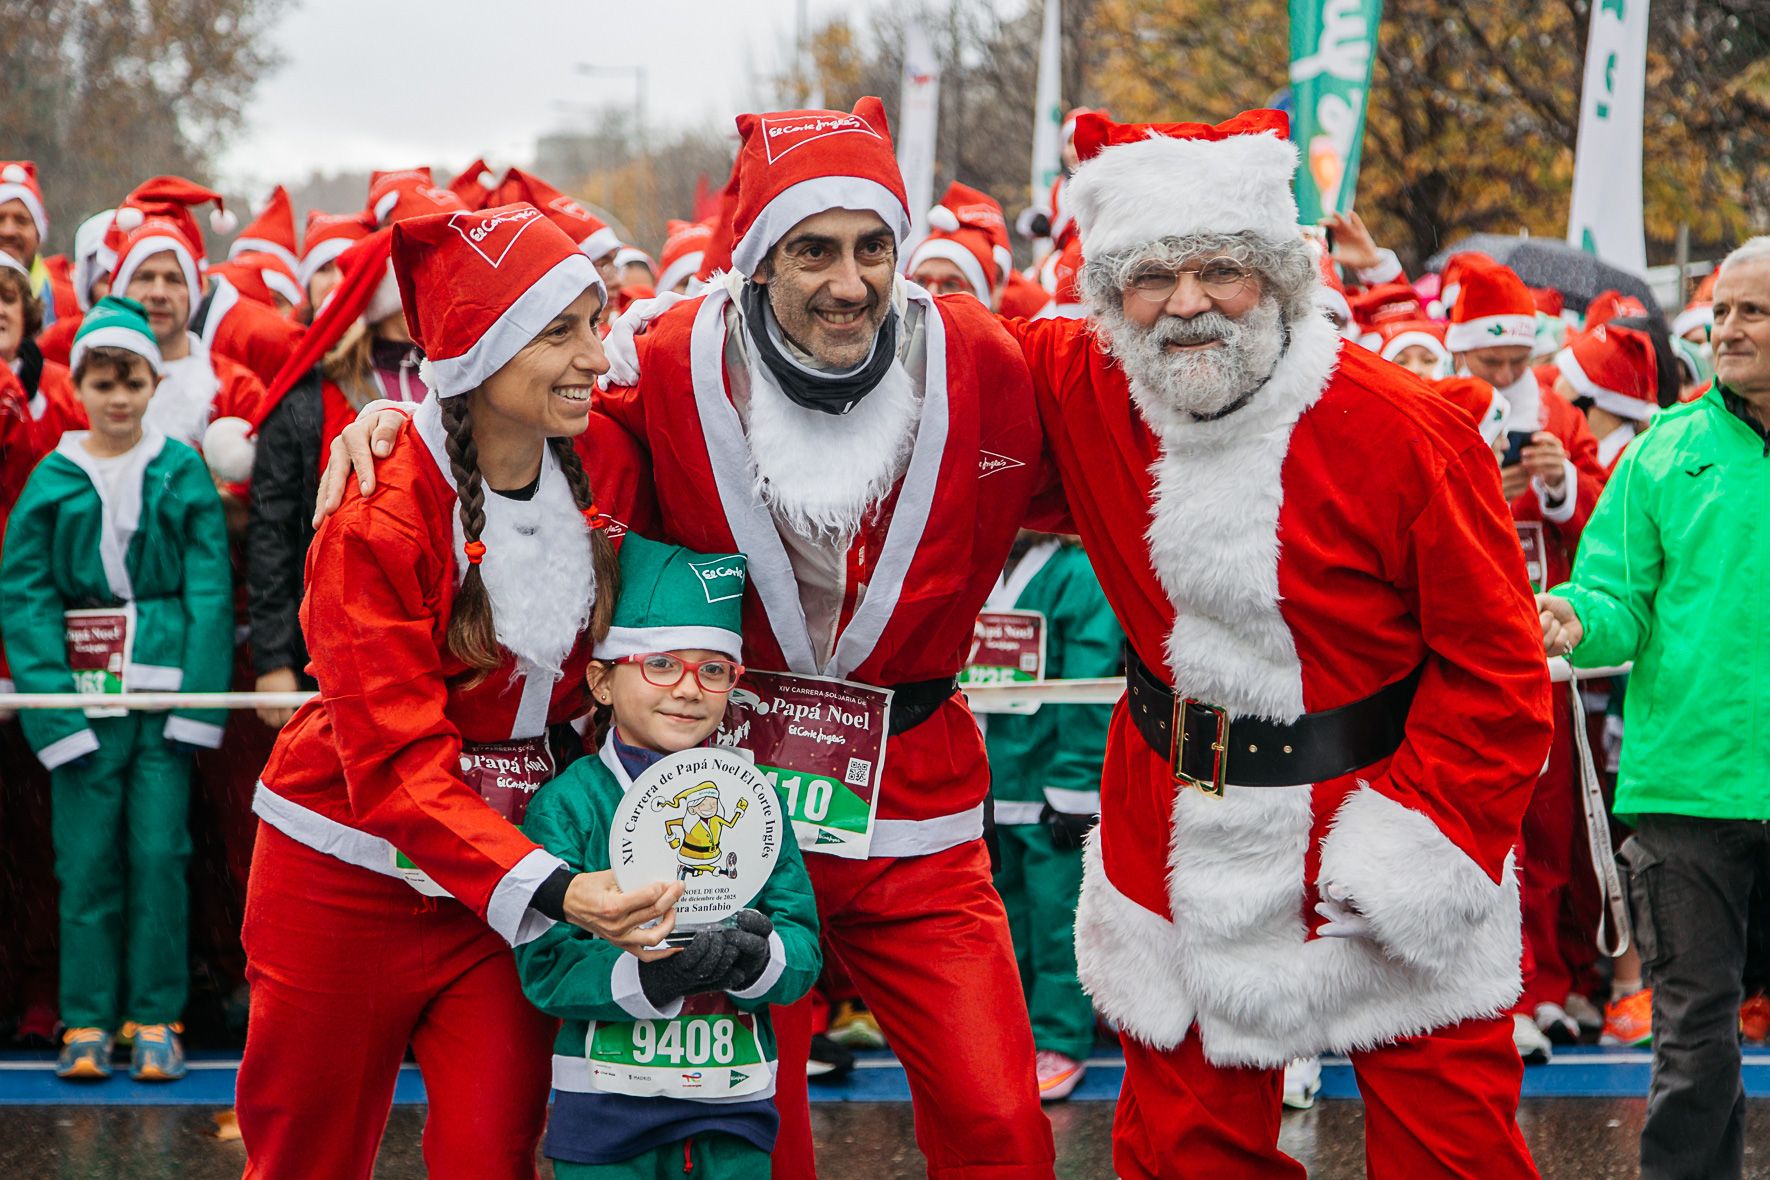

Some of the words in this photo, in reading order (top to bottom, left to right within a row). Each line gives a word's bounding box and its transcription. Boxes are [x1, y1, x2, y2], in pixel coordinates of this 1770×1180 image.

[791, 686, 824, 697] CARRERA
[857, 698, 867, 706] DE
[770, 697, 821, 722] Papá
[826, 704, 870, 730] Noel
[676, 758, 708, 775] Papá
[712, 758, 741, 776] Noel
[659, 772, 674, 785] de
[740, 769, 755, 785] El
[624, 784, 659, 833] Carrera
[752, 783, 773, 817] Corte
[761, 819, 776, 859] Inglés
[622, 838, 634, 866] XIV
[684, 888, 703, 896] NOEL
[692, 902, 731, 913] Sanfabio
[632, 1018, 734, 1064] 9408
